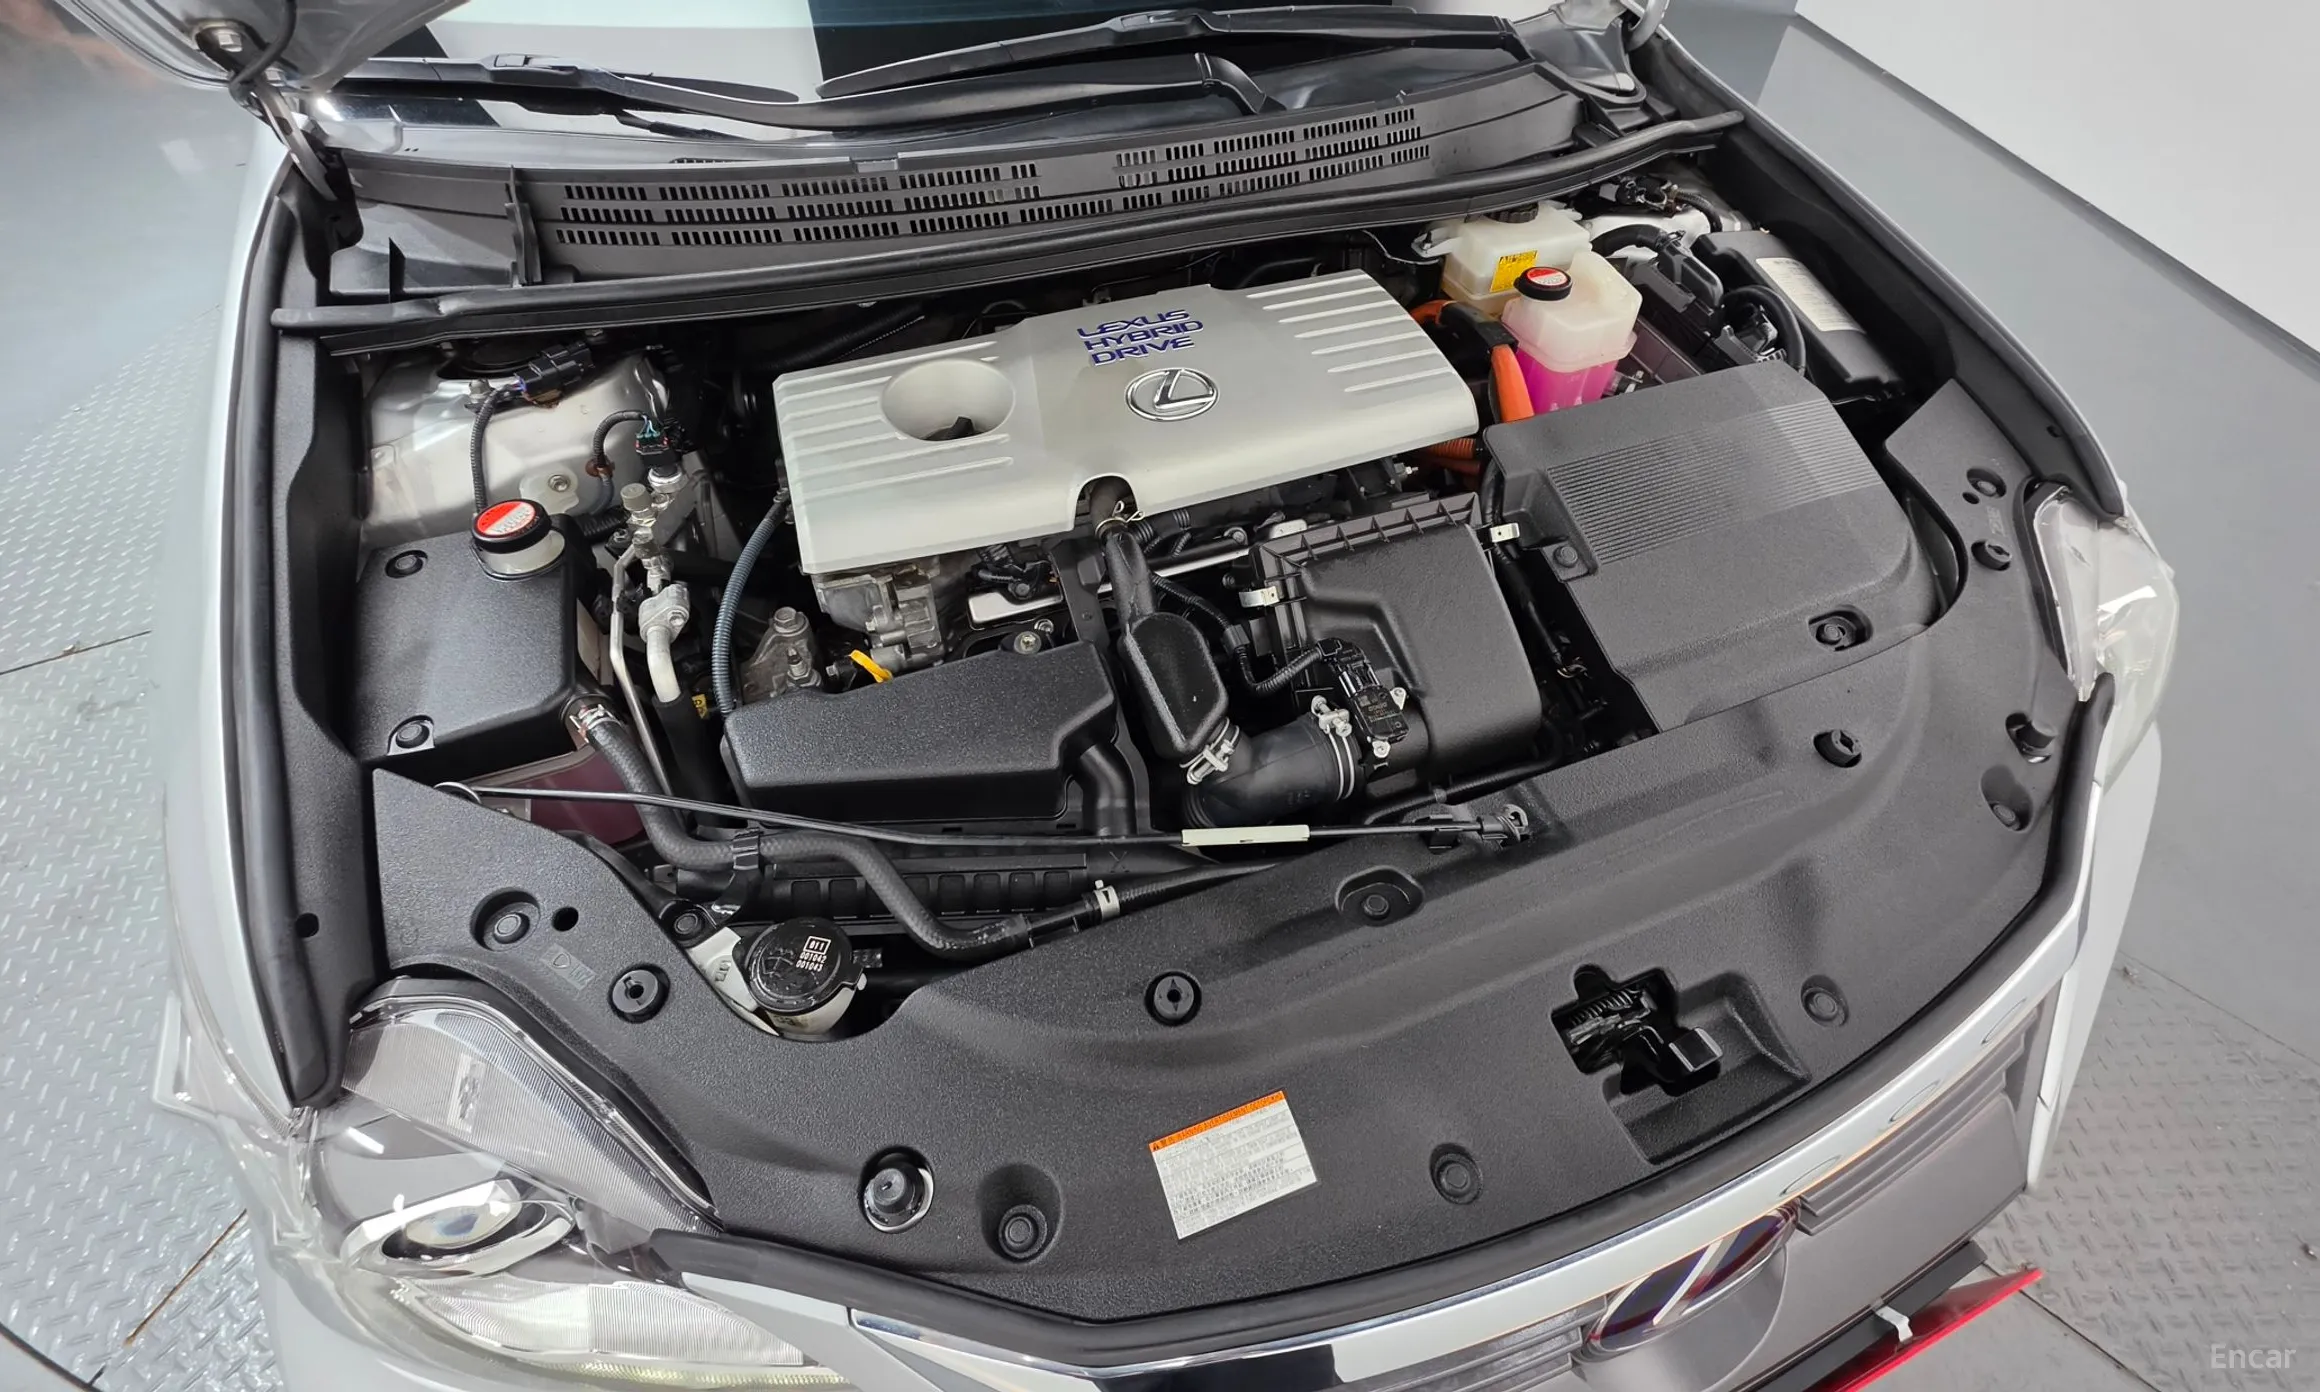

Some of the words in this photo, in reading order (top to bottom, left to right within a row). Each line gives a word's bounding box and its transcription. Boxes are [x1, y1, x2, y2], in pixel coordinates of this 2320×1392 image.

[1077, 309, 1191, 338] LEXUS
[1084, 321, 1204, 351] HYBRID
[1091, 336, 1195, 366] DRIVE
